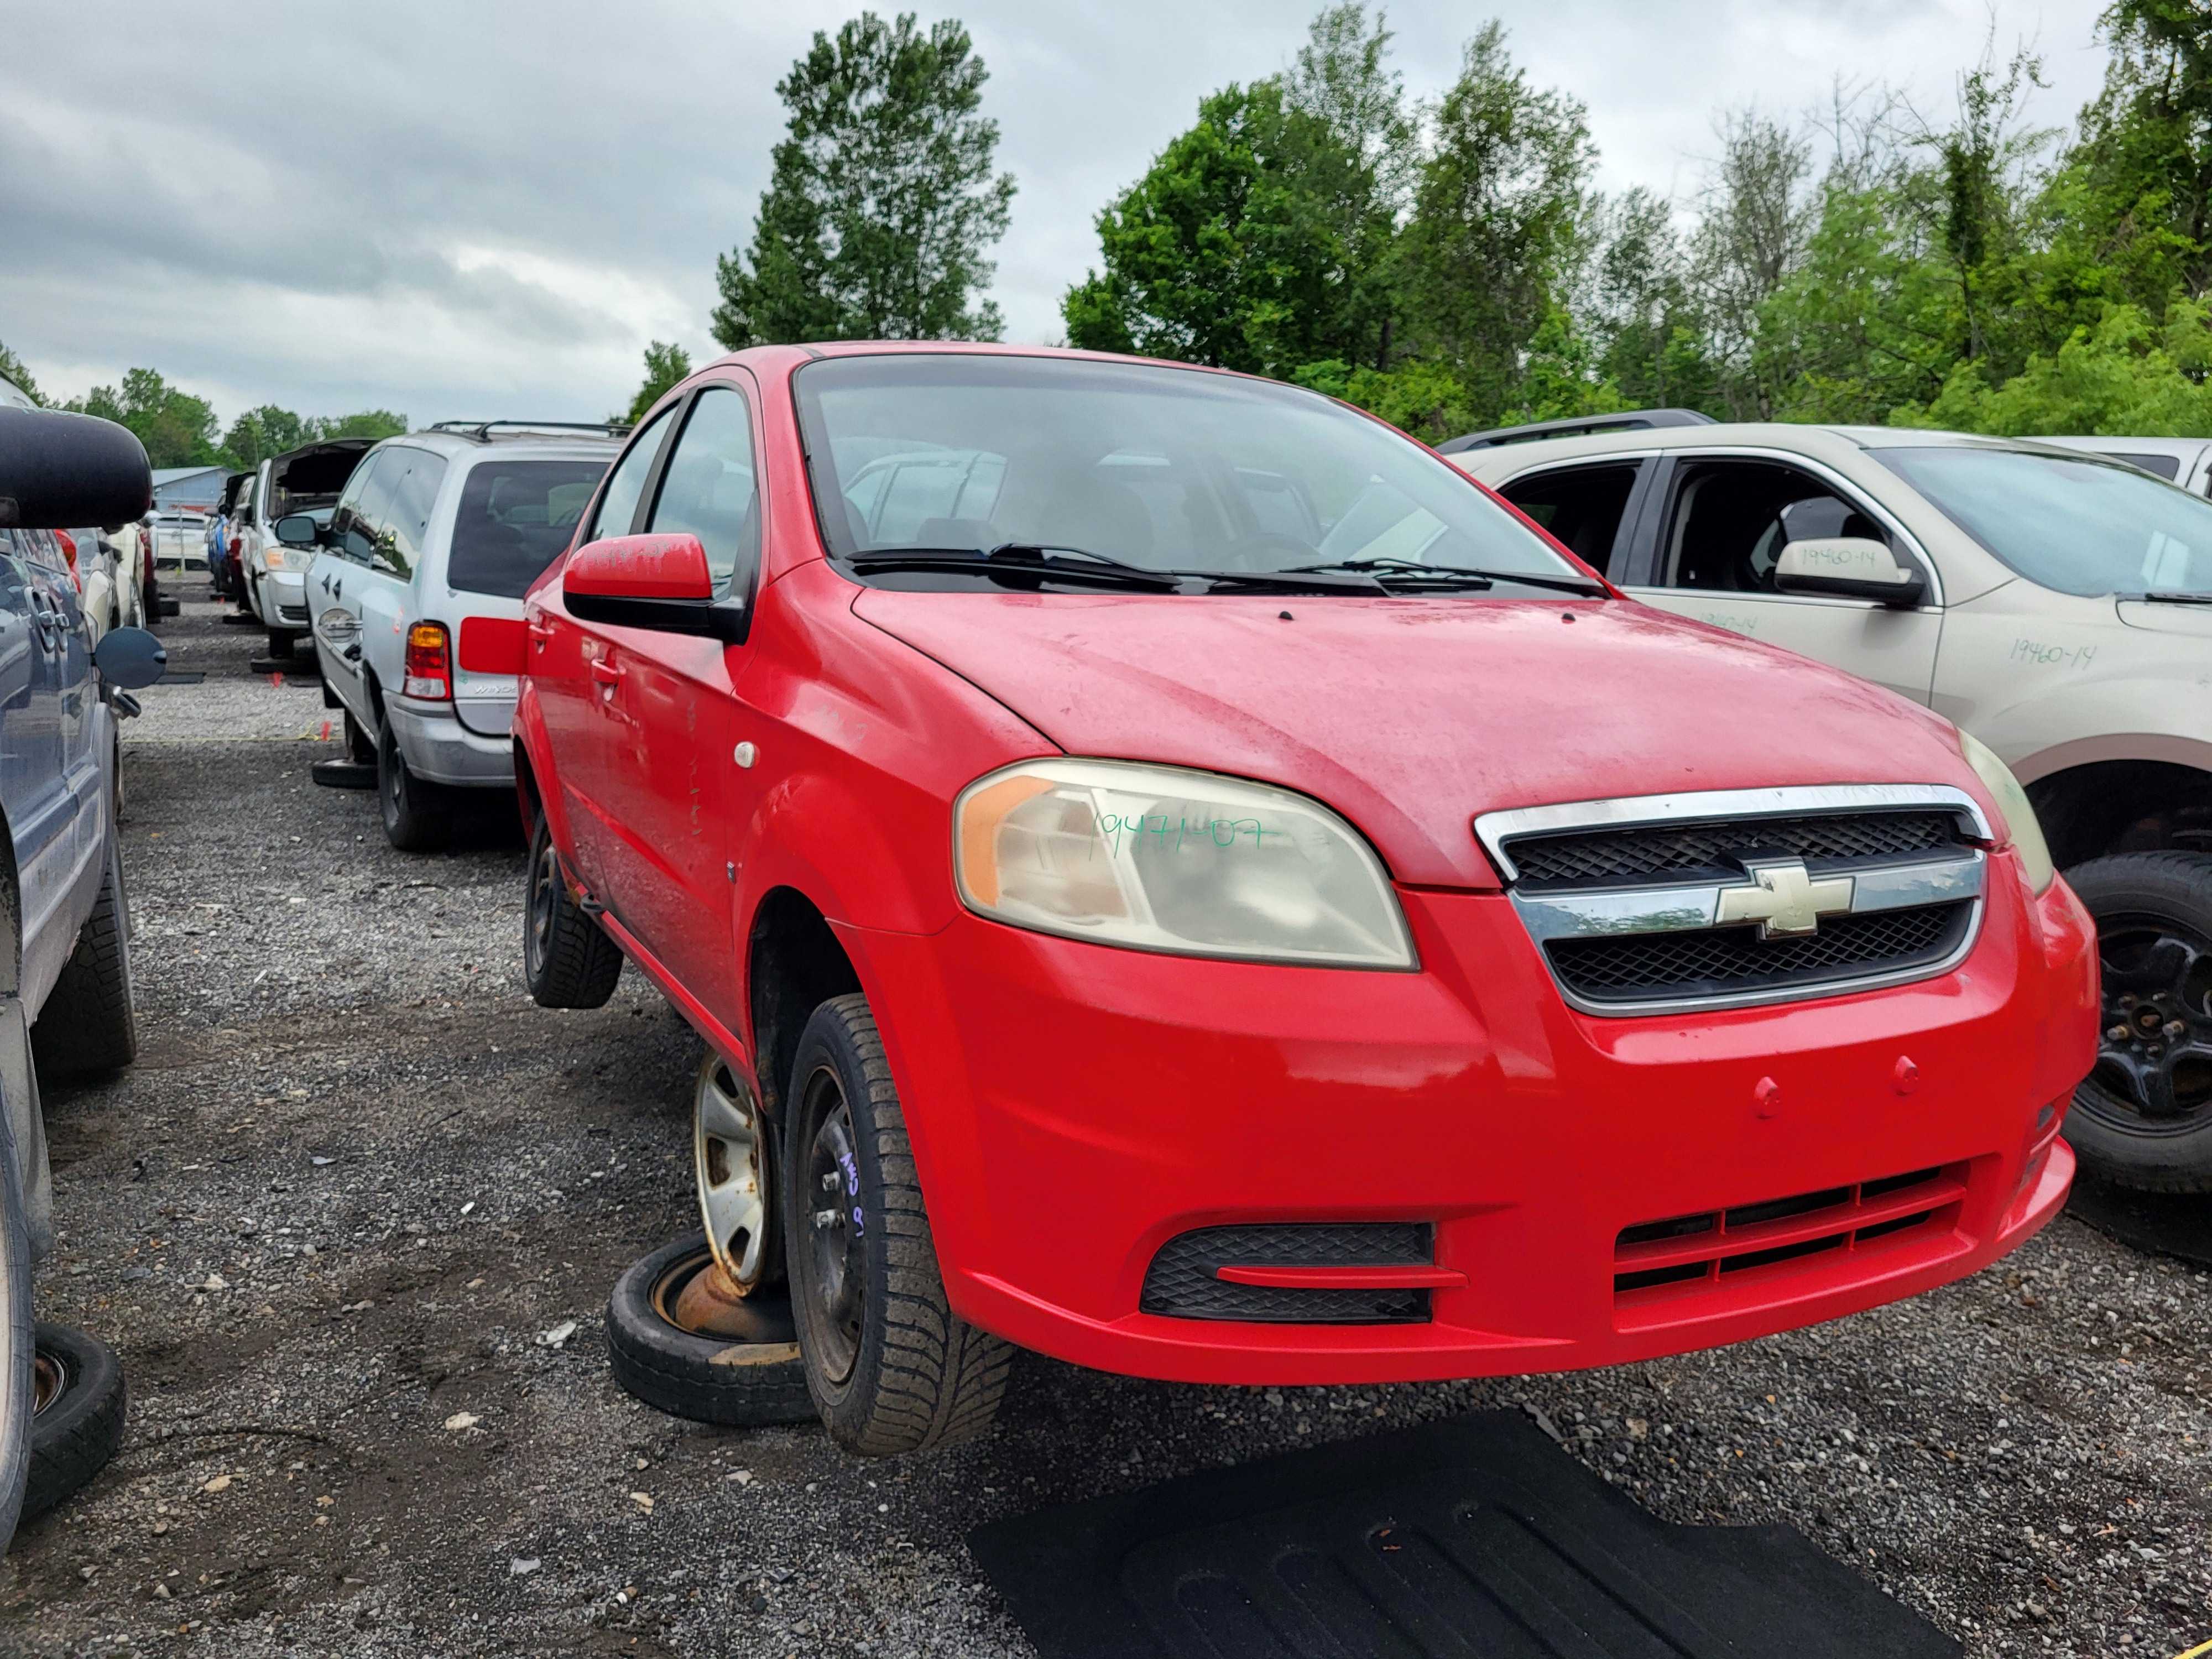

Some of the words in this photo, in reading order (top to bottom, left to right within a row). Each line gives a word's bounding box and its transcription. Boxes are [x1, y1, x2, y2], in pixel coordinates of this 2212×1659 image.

[1802, 548, 1876, 568] 19460-14
[2010, 638, 2098, 671] 19460-14
[1088, 812, 1283, 862] 19471-07
